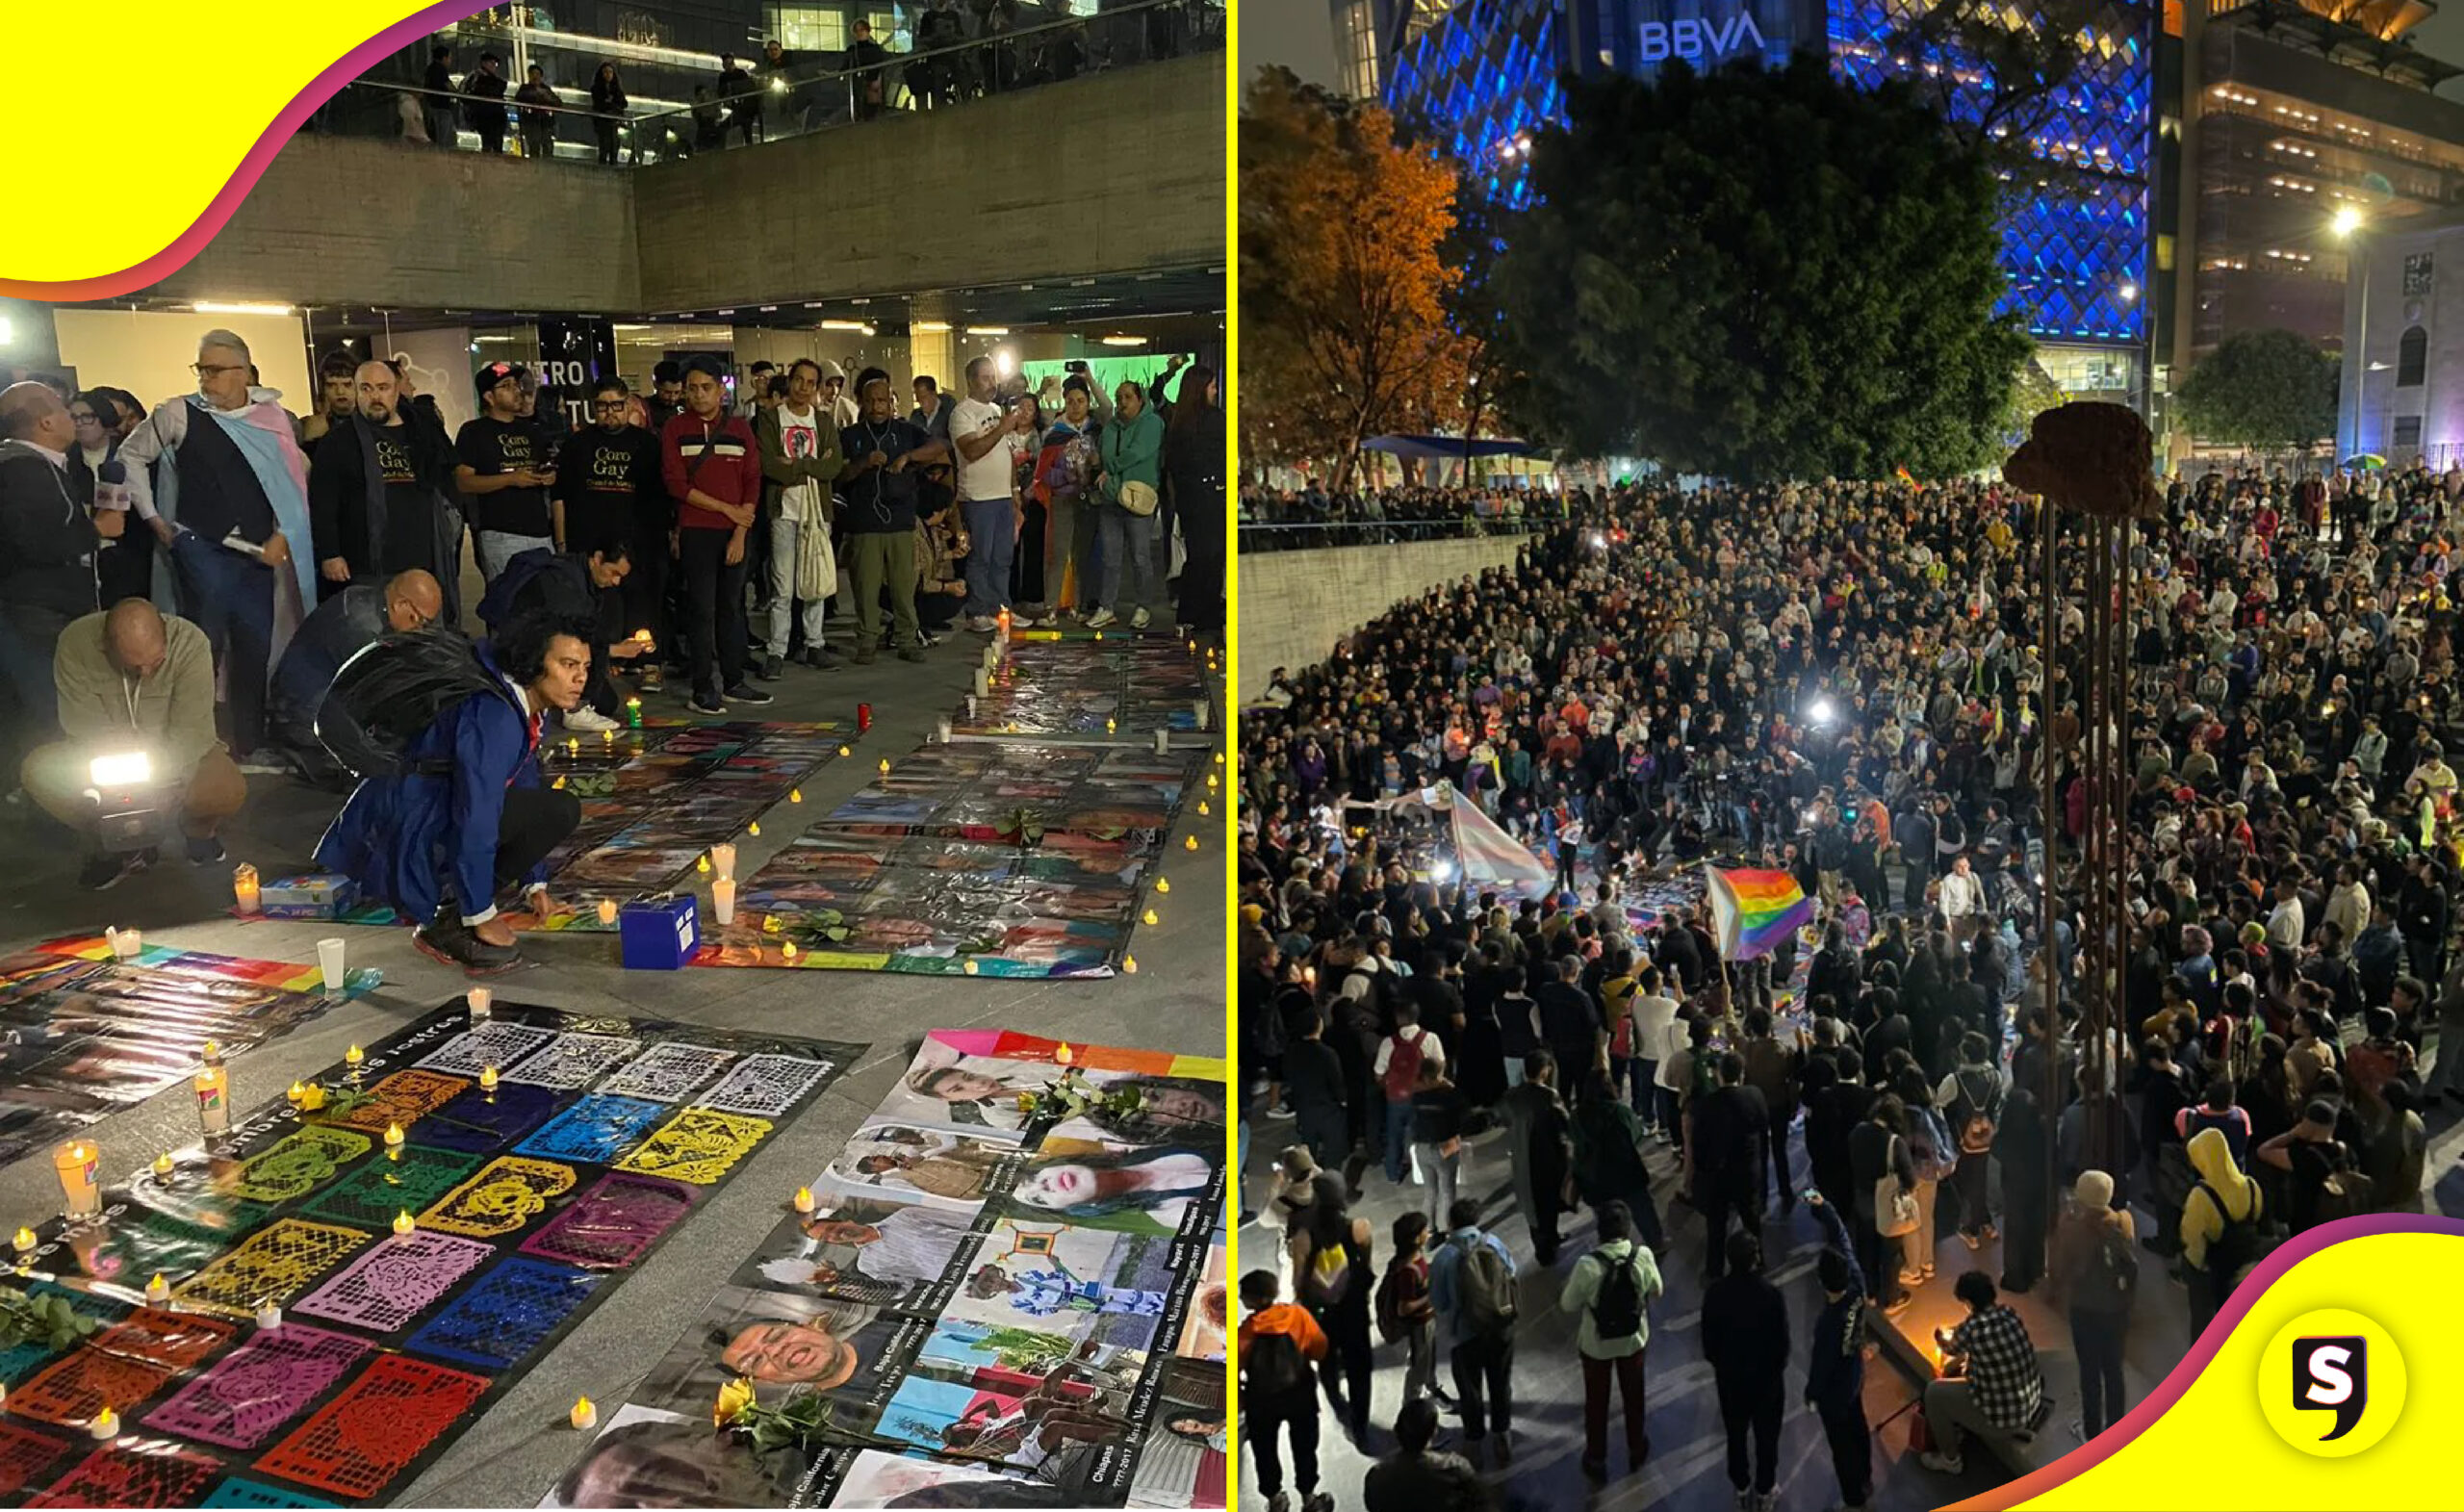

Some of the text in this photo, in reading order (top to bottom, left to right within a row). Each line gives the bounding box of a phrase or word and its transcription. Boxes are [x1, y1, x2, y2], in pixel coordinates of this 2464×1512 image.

[1640, 10, 1765, 61] BBVA
[482, 360, 584, 386] TRO
[593, 460, 629, 479] Gay
[595, 447, 631, 462] Coro
[213, 1108, 297, 1155] ombre
[873, 1318, 912, 1372] Baja California
[788, 1447, 831, 1509] aja California
[1092, 1445, 1115, 1483] Chiapas
